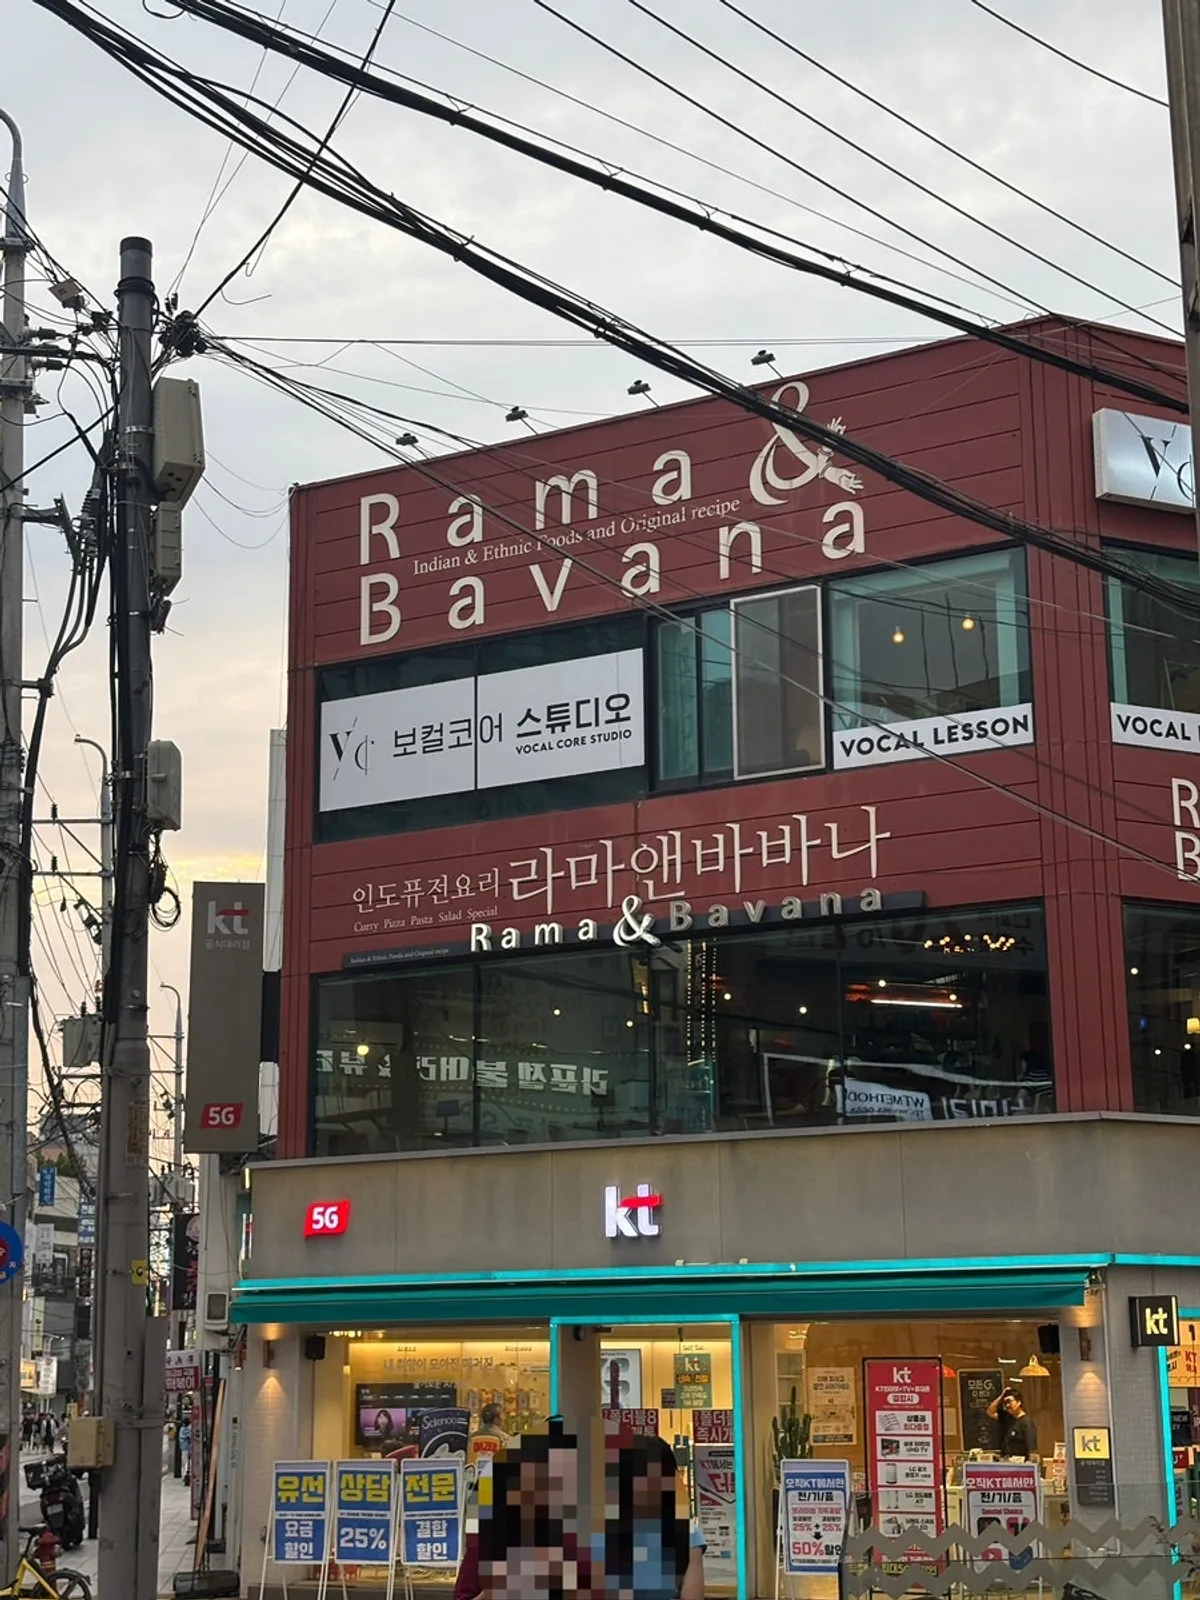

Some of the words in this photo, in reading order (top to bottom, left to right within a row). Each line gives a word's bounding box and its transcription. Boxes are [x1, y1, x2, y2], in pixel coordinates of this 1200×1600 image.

[360, 449, 693, 566] Rama
[413, 554, 460, 575] Indian
[464, 549, 478, 565] &
[483, 539, 532, 562] Ethnic
[587, 521, 616, 541] and
[621, 506, 687, 532] Original
[691, 499, 740, 520] recipe
[360, 501, 865, 646] Bavana
[392, 712, 503, 759] 보컬코어
[516, 692, 632, 739] 스튜디오
[840, 729, 924, 757] VOCAL
[933, 714, 1030, 746] LESSON
[1116, 713, 1192, 741] VOCAL
[516, 742, 554, 755] VOCAL
[557, 736, 587, 750] CORE
[590, 728, 632, 745] STUDIO
[352, 867, 499, 914] 인도퓨전요리
[508, 806, 891, 915] 라마앤바바나
[207, 900, 251, 935] kt
[354, 921, 379, 933] Curry
[384, 918, 406, 929] Pizza
[411, 914, 434, 926] Pasta
[438, 909, 462, 923] Salad
[467, 905, 498, 920] Special
[470, 916, 598, 953] Rama
[613, 895, 661, 948] &
[669, 887, 882, 932] Bavana
[207, 1106, 236, 1126] 5G
[311, 1206, 339, 1230] 5G
[605, 1184, 662, 1238] kt
[1145, 1307, 1168, 1335] kt
[685, 1357, 700, 1372] kt
[893, 1366, 912, 1384] kt
[1081, 1435, 1101, 1452] kt
[278, 1474, 324, 1503] 유선
[340, 1473, 391, 1503] 상담
[405, 1472, 455, 1503] 전문
[285, 1520, 313, 1538] 요금
[340, 1527, 387, 1550] 25%
[416, 1520, 448, 1539] 결합
[284, 1542, 313, 1559] 할인
[416, 1542, 448, 1561] 할인
